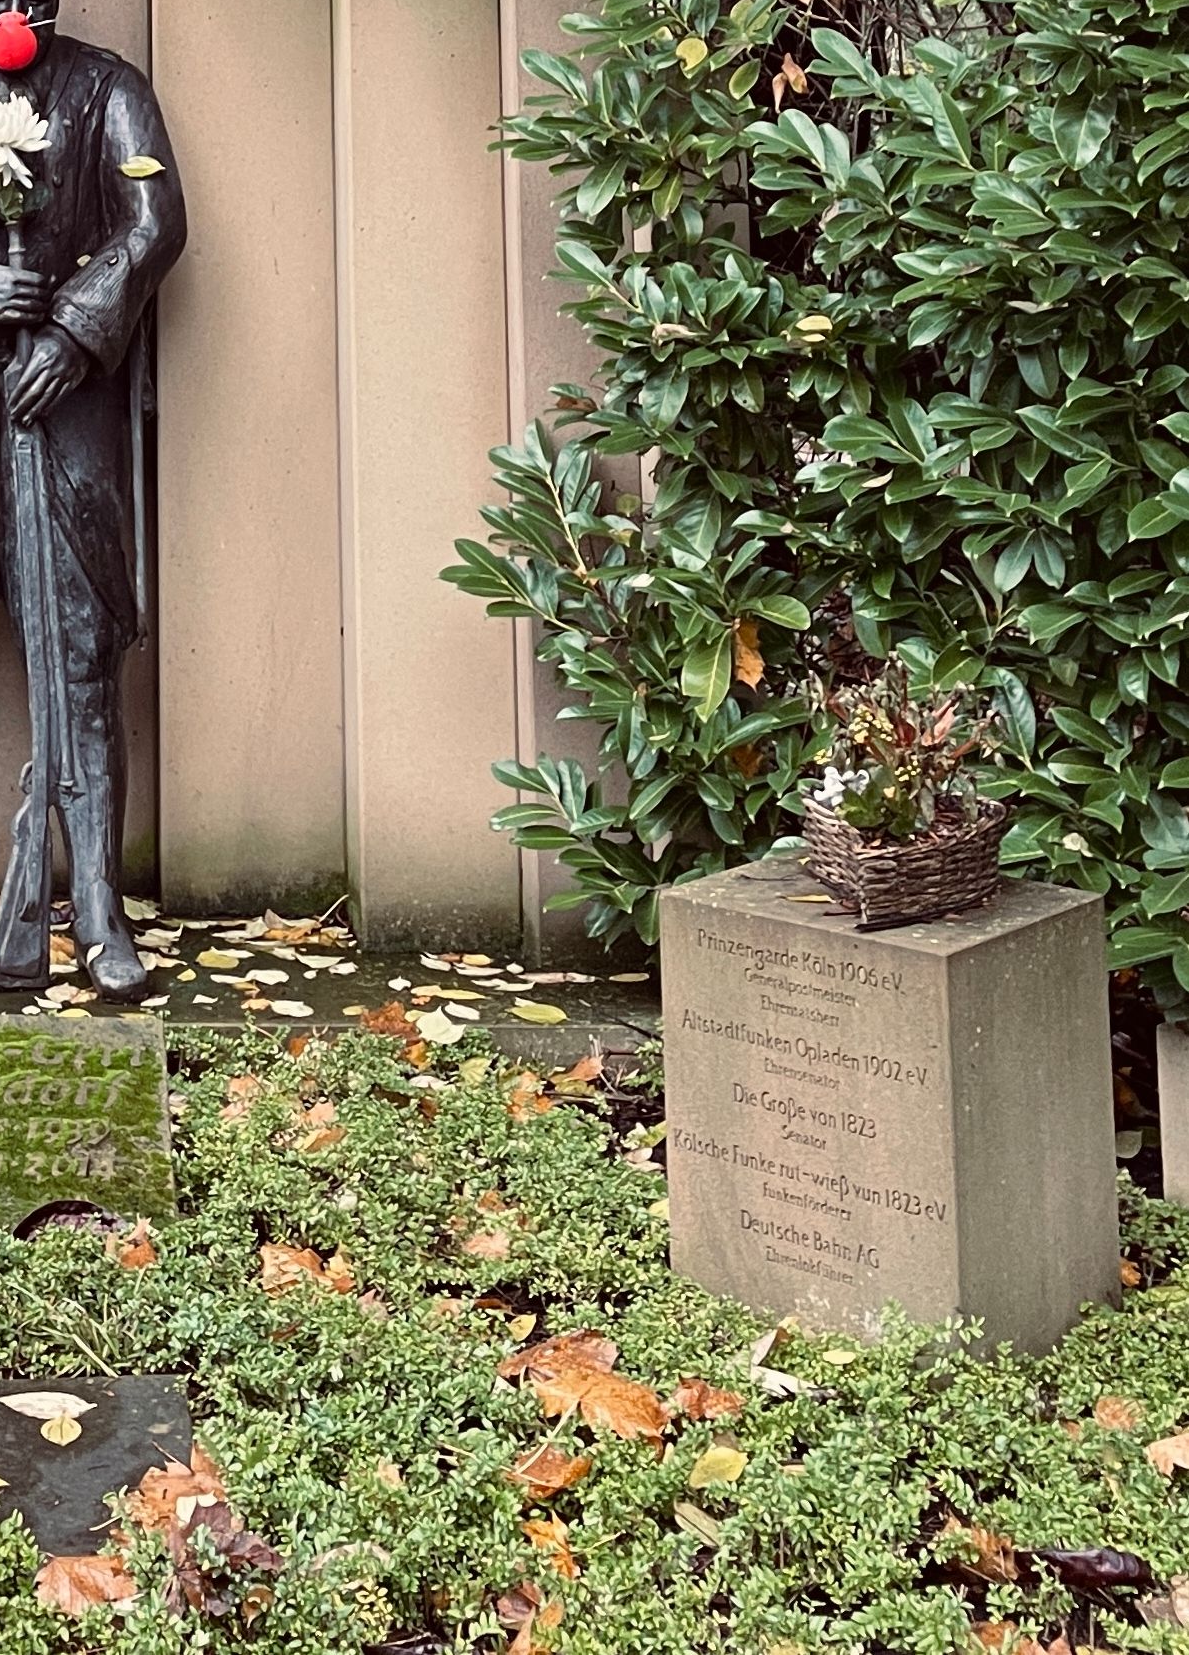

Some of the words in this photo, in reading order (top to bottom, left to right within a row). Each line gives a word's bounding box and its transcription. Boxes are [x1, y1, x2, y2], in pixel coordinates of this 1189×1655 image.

[697, 928, 799, 971] Prinzengarde
[801, 951, 837, 979] Köln
[839, 961, 879, 988] 1906
[681, 1008, 792, 1055] Altstadtfunken
[795, 1037, 860, 1072] Opladen
[862, 1055, 903, 1083] 1902
[764, 1056, 841, 1092] Ehrensenator
[732, 1082, 758, 1107] Die
[760, 1090, 806, 1124] Große
[809, 1108, 837, 1129] von
[840, 1111, 877, 1139] 1823
[780, 1124, 827, 1151] Senator
[673, 1127, 730, 1162] Kölsche
[732, 1144, 777, 1175] Funke
[779, 1163, 850, 1202] rut-wieß
[852, 1183, 881, 1205] vun
[884, 1188, 921, 1216] 1823
[740, 1208, 811, 1248] Deutsche
[813, 1230, 852, 1262] Bahn
[855, 1243, 880, 1269] AG
